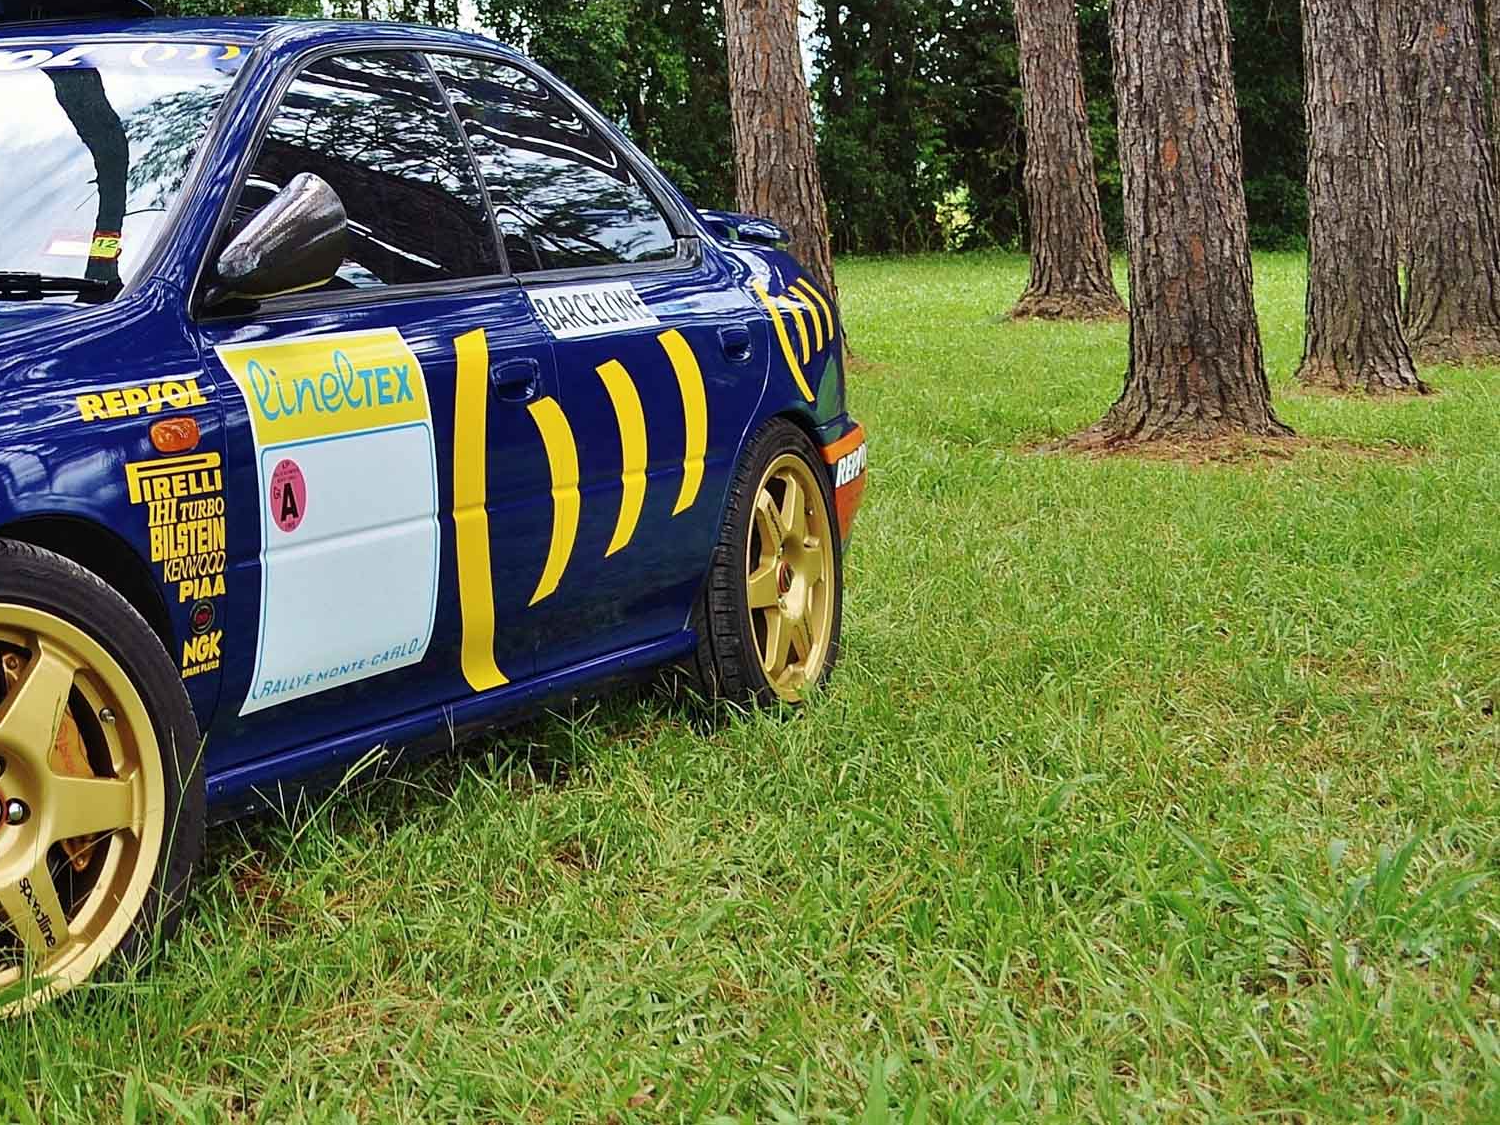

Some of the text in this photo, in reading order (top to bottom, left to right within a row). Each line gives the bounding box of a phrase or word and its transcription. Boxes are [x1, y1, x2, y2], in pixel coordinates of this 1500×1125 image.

[534, 289, 653, 331] BARCELONE
[76, 377, 207, 422] REPSOL
[125, 452, 223, 504] PIRELLI
[148, 497, 225, 527] IHI TURBO
[150, 516, 226, 562] BILSTEIN
[164, 551, 226, 583] KENWOOD
[179, 574, 226, 603] PIAA
[182, 629, 222, 668] NGK
[259, 674, 315, 700] RALLYE
